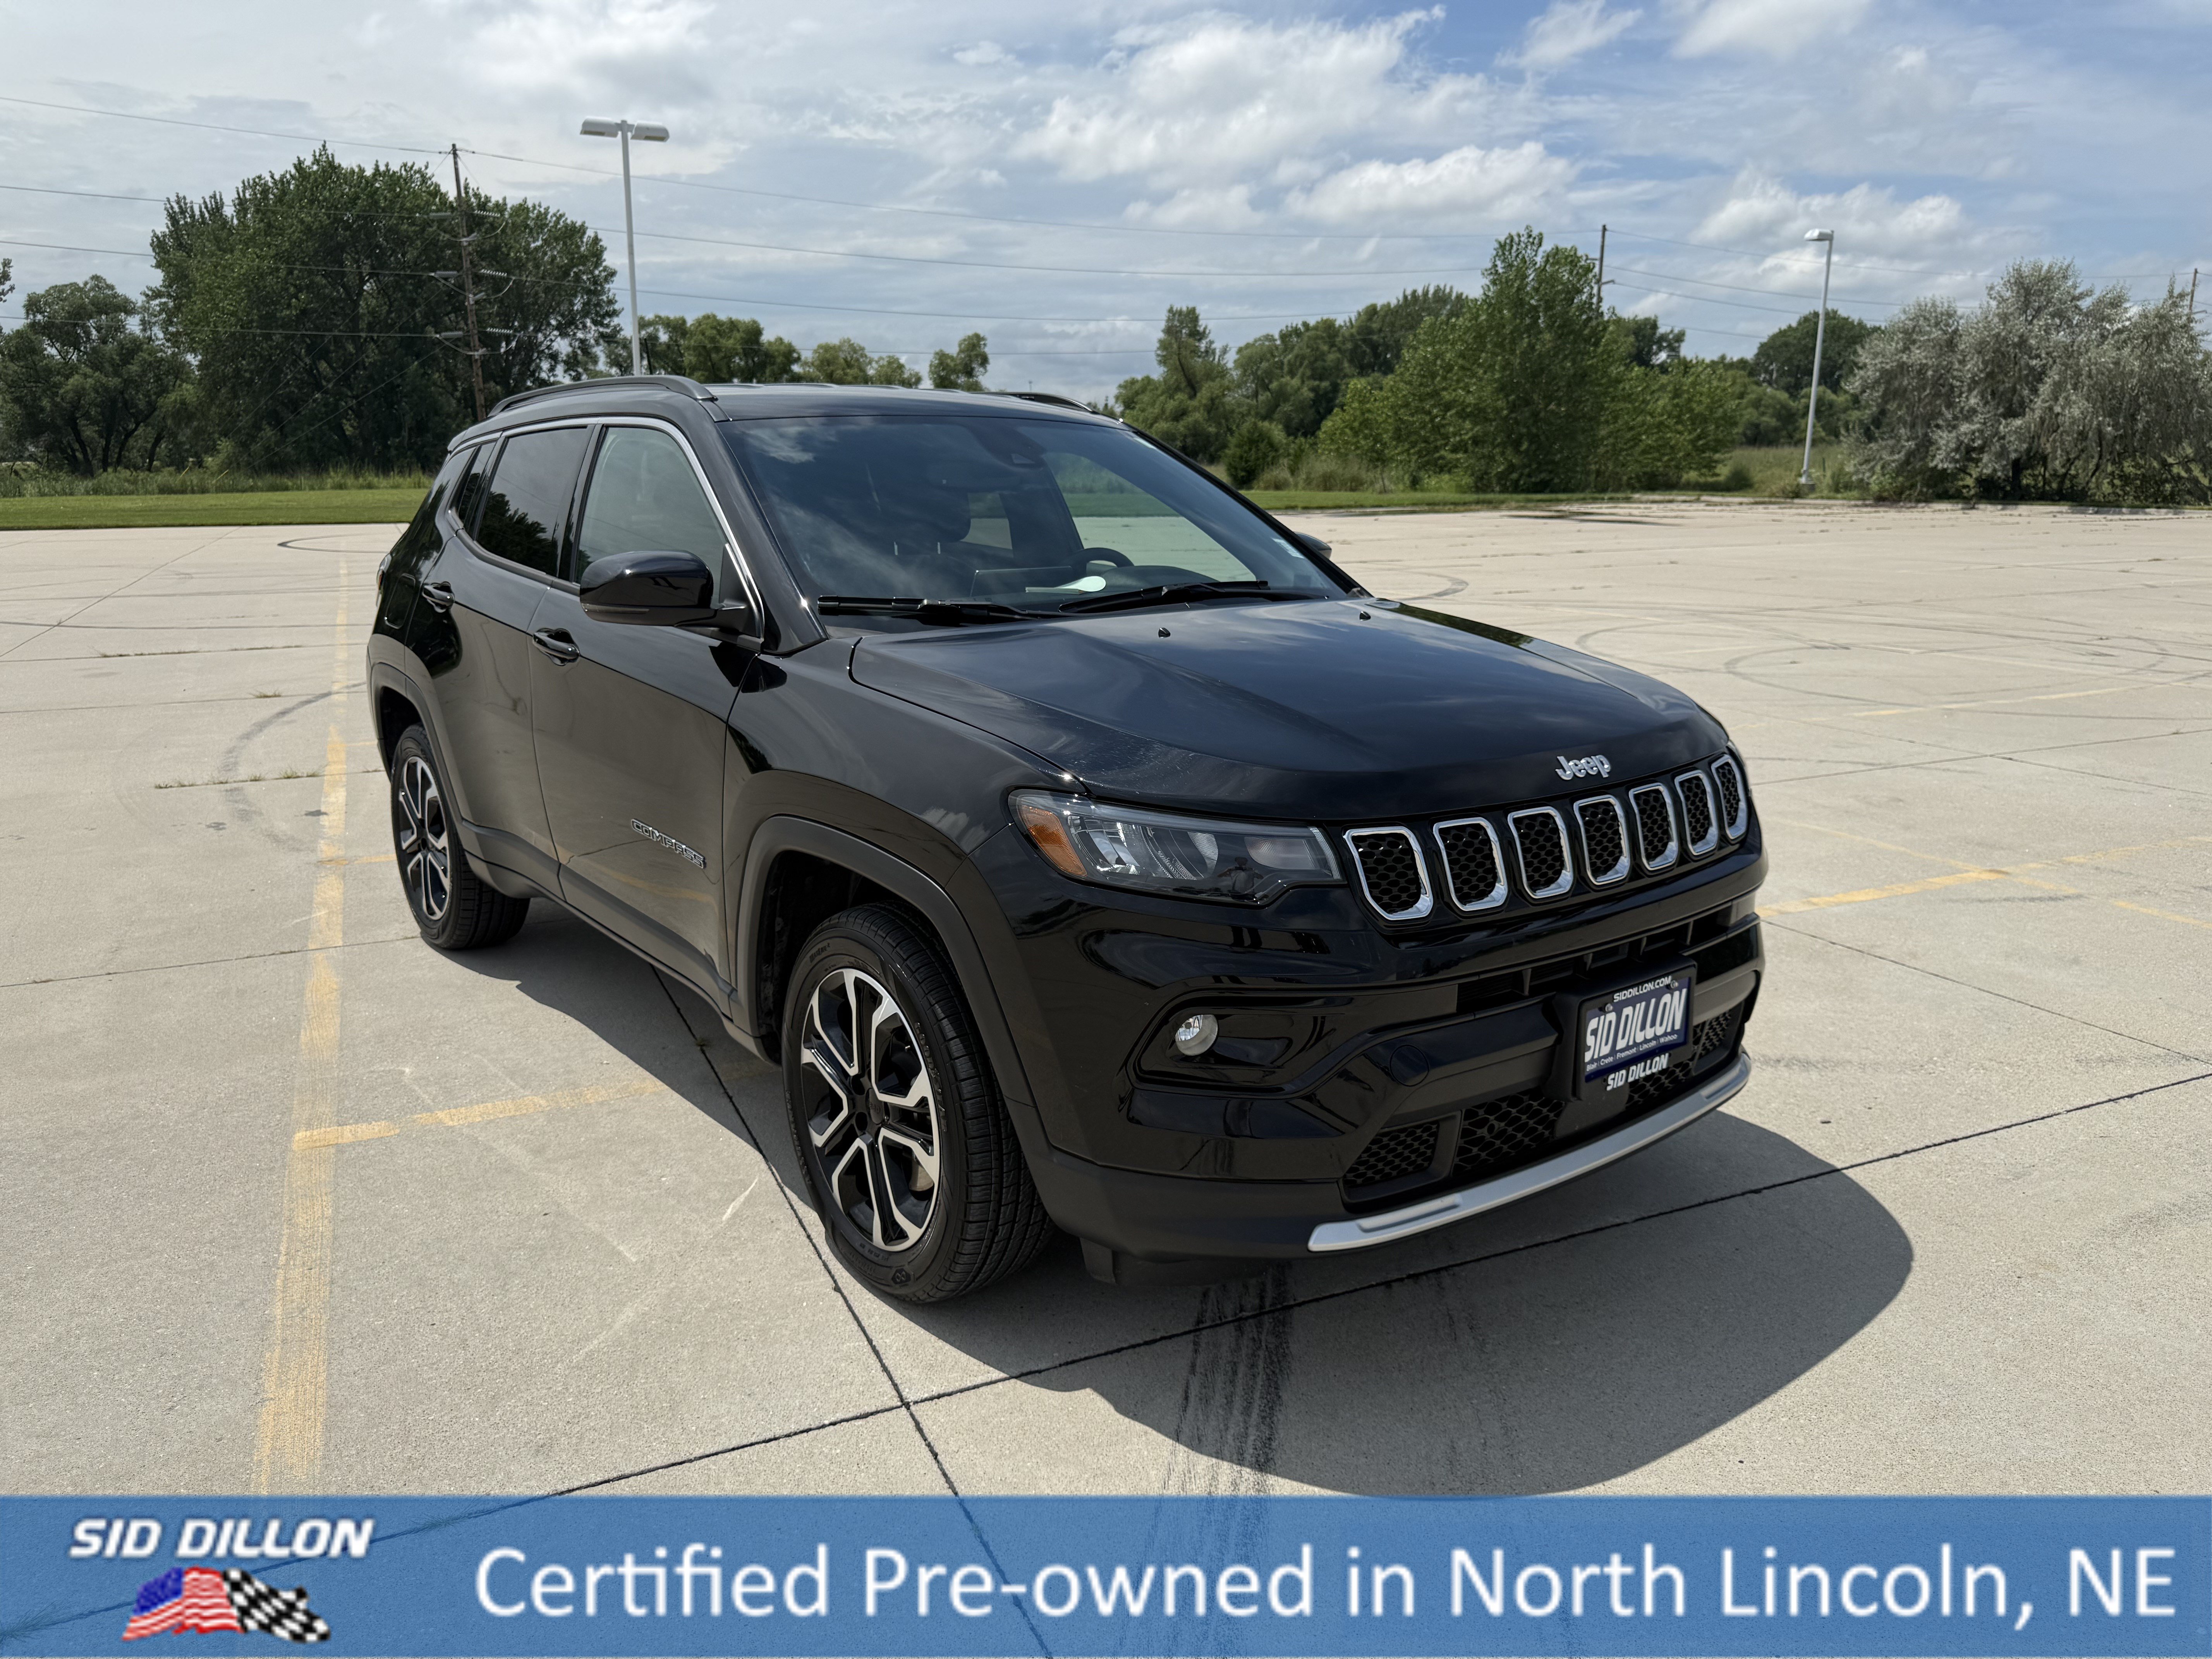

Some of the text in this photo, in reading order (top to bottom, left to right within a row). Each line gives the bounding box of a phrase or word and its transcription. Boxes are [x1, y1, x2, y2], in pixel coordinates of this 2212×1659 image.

[1555, 755, 1611, 780] Jeep
[631, 819, 705, 869] COMPASS
[1613, 975, 1672, 1002] SIDDILLON.COM
[1585, 988, 1687, 1062] SID DILLON
[1600, 1056, 1614, 1065] Crete
[1616, 1048, 1637, 1059] Fremont
[1640, 1041, 1656, 1051] Lincoln
[1659, 1034, 1678, 1043] Wahoo
[1607, 1053, 1669, 1091] SID DILLON
